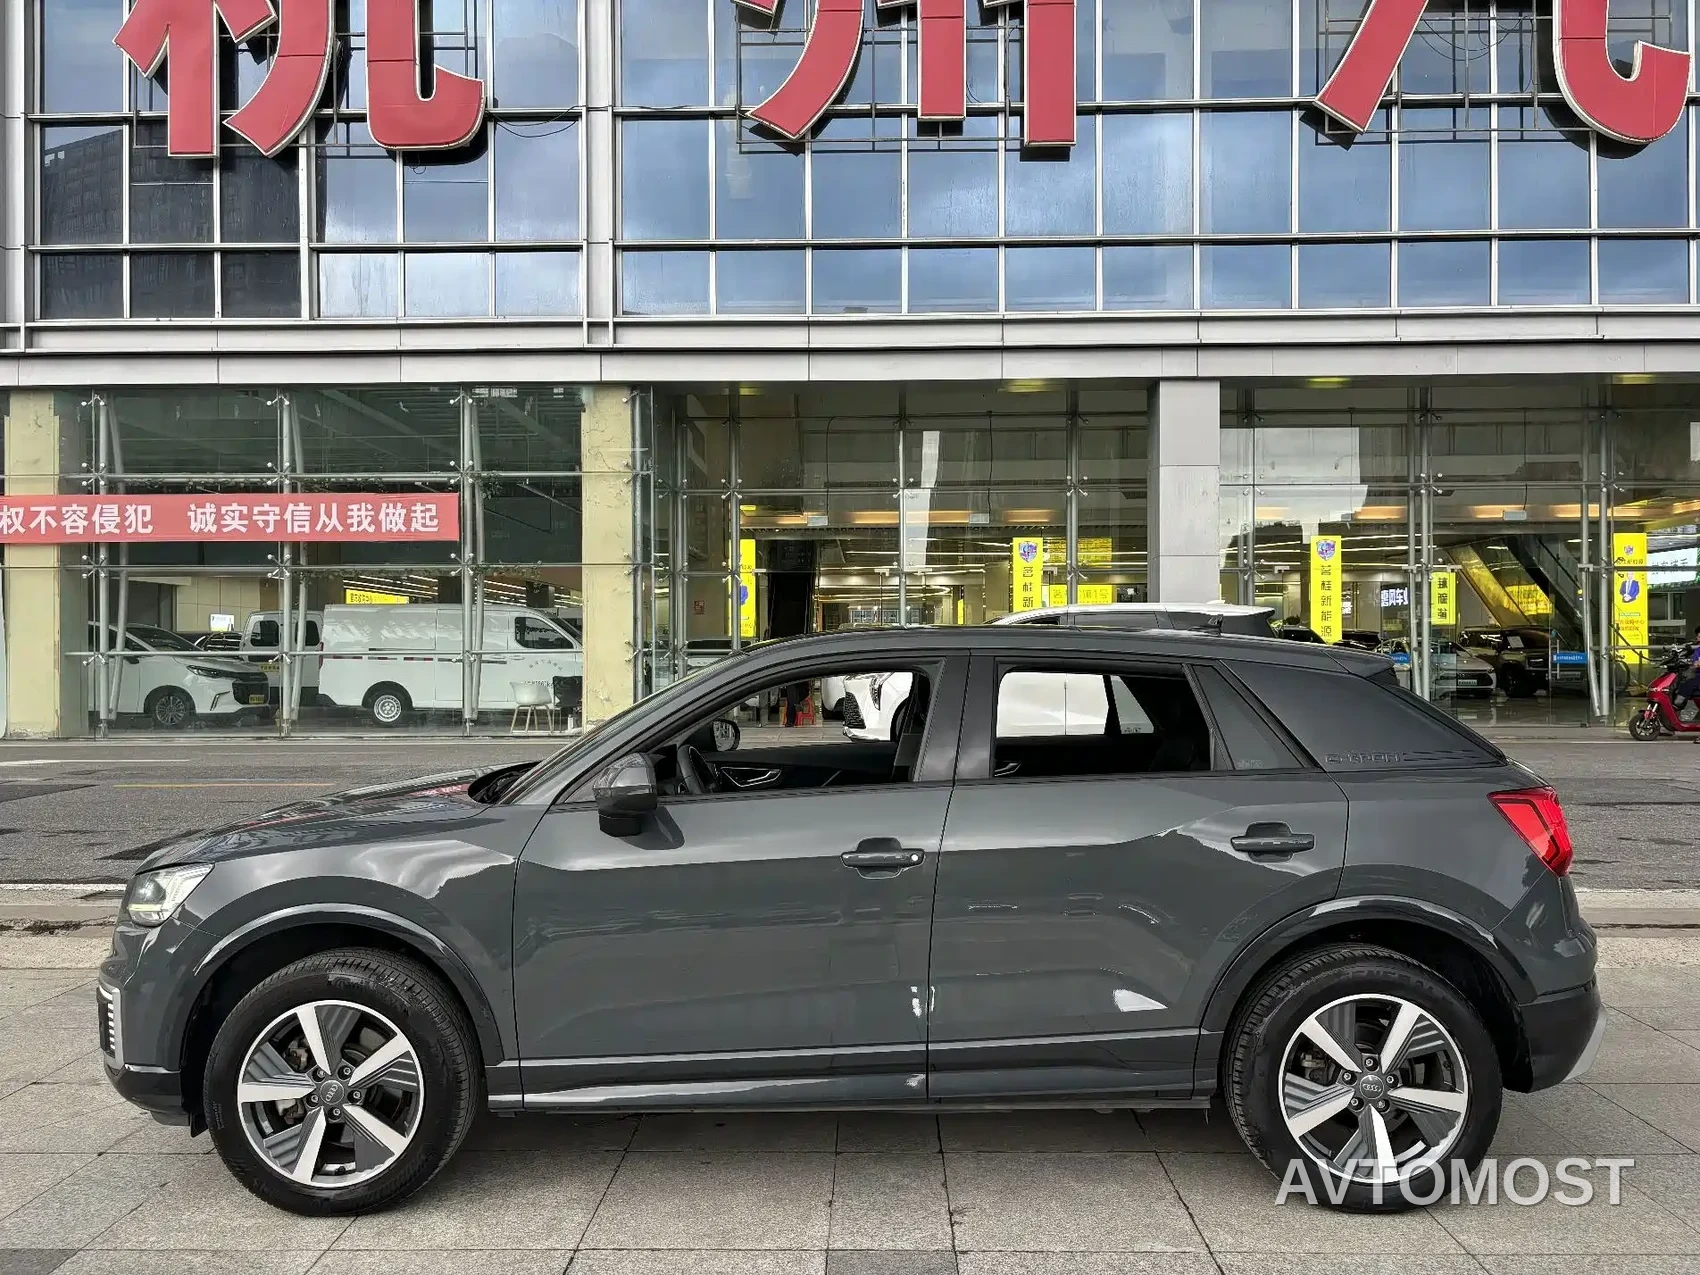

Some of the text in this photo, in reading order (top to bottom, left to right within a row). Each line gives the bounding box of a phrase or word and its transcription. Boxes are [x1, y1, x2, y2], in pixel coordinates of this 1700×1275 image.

[0, 502, 439, 535] 权不容侵犯 诚实守信从我做起
